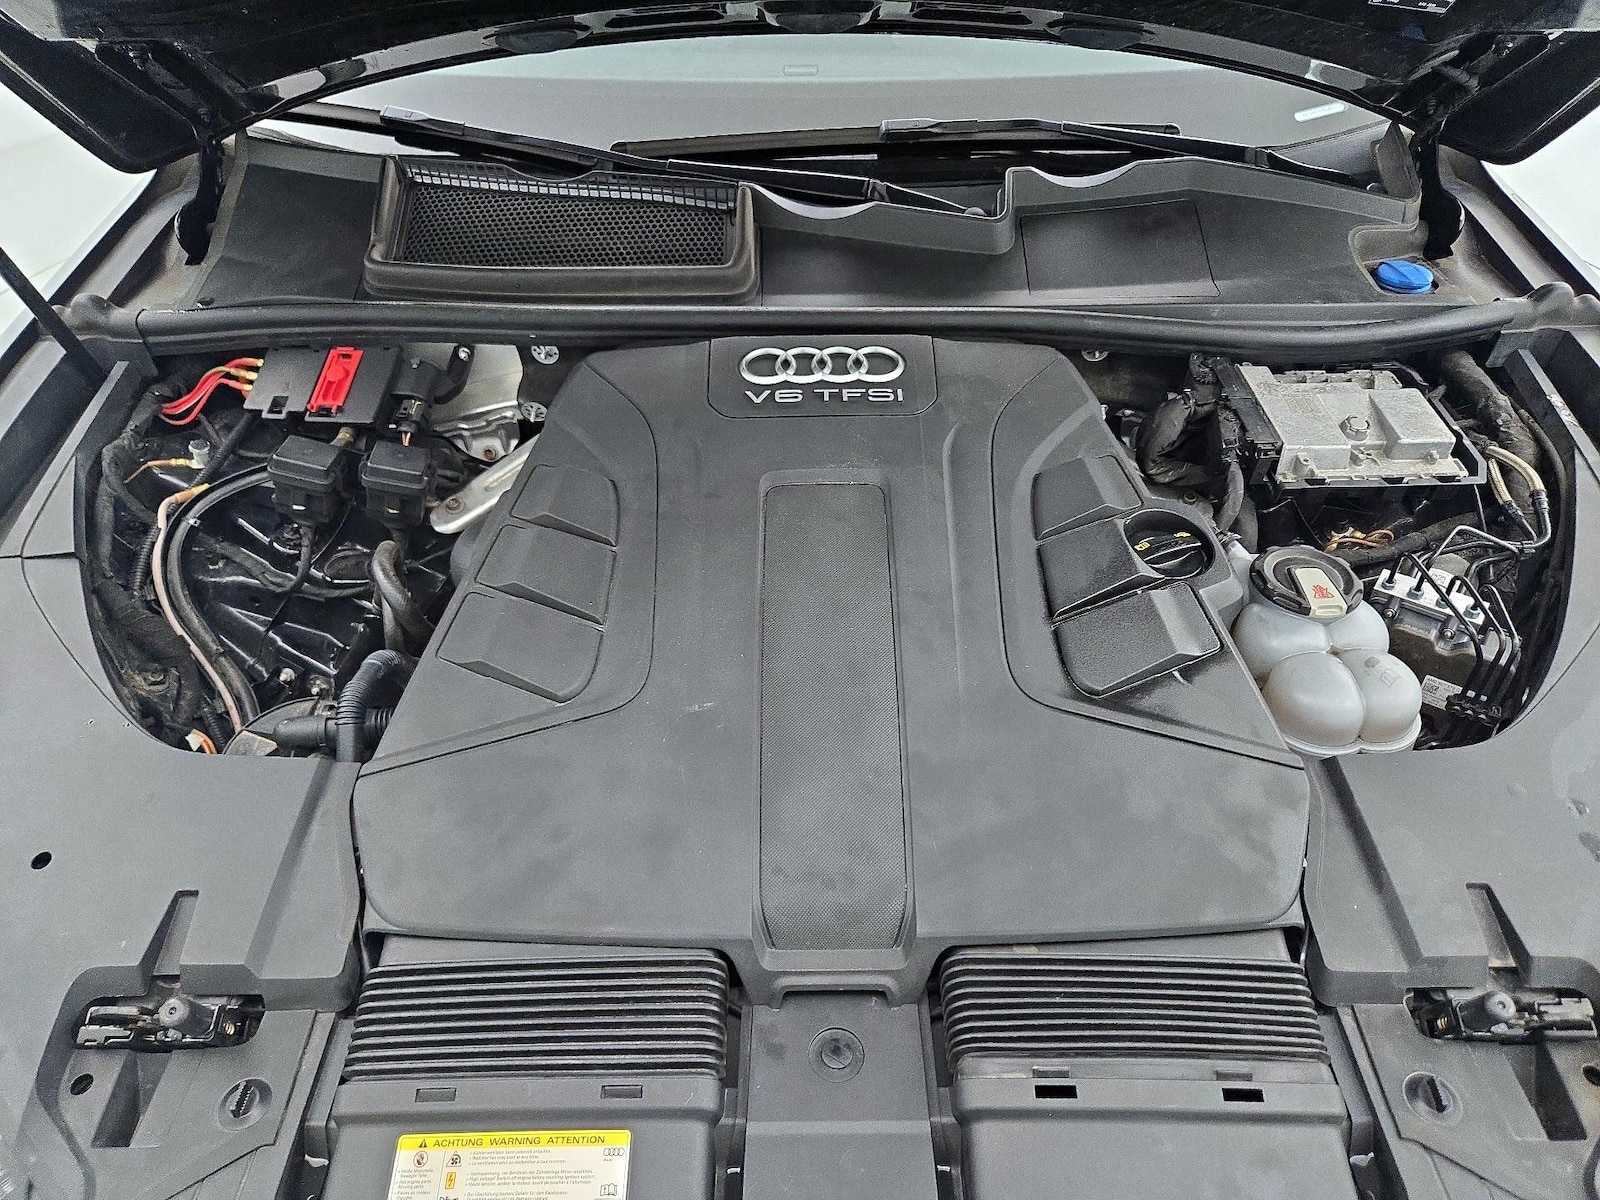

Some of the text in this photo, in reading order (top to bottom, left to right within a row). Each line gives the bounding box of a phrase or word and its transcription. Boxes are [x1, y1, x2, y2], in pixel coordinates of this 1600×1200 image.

[745, 388, 903, 403] V6 TFSI
[433, 1135, 605, 1147] ACHTUNG WARNING ATTENTION
